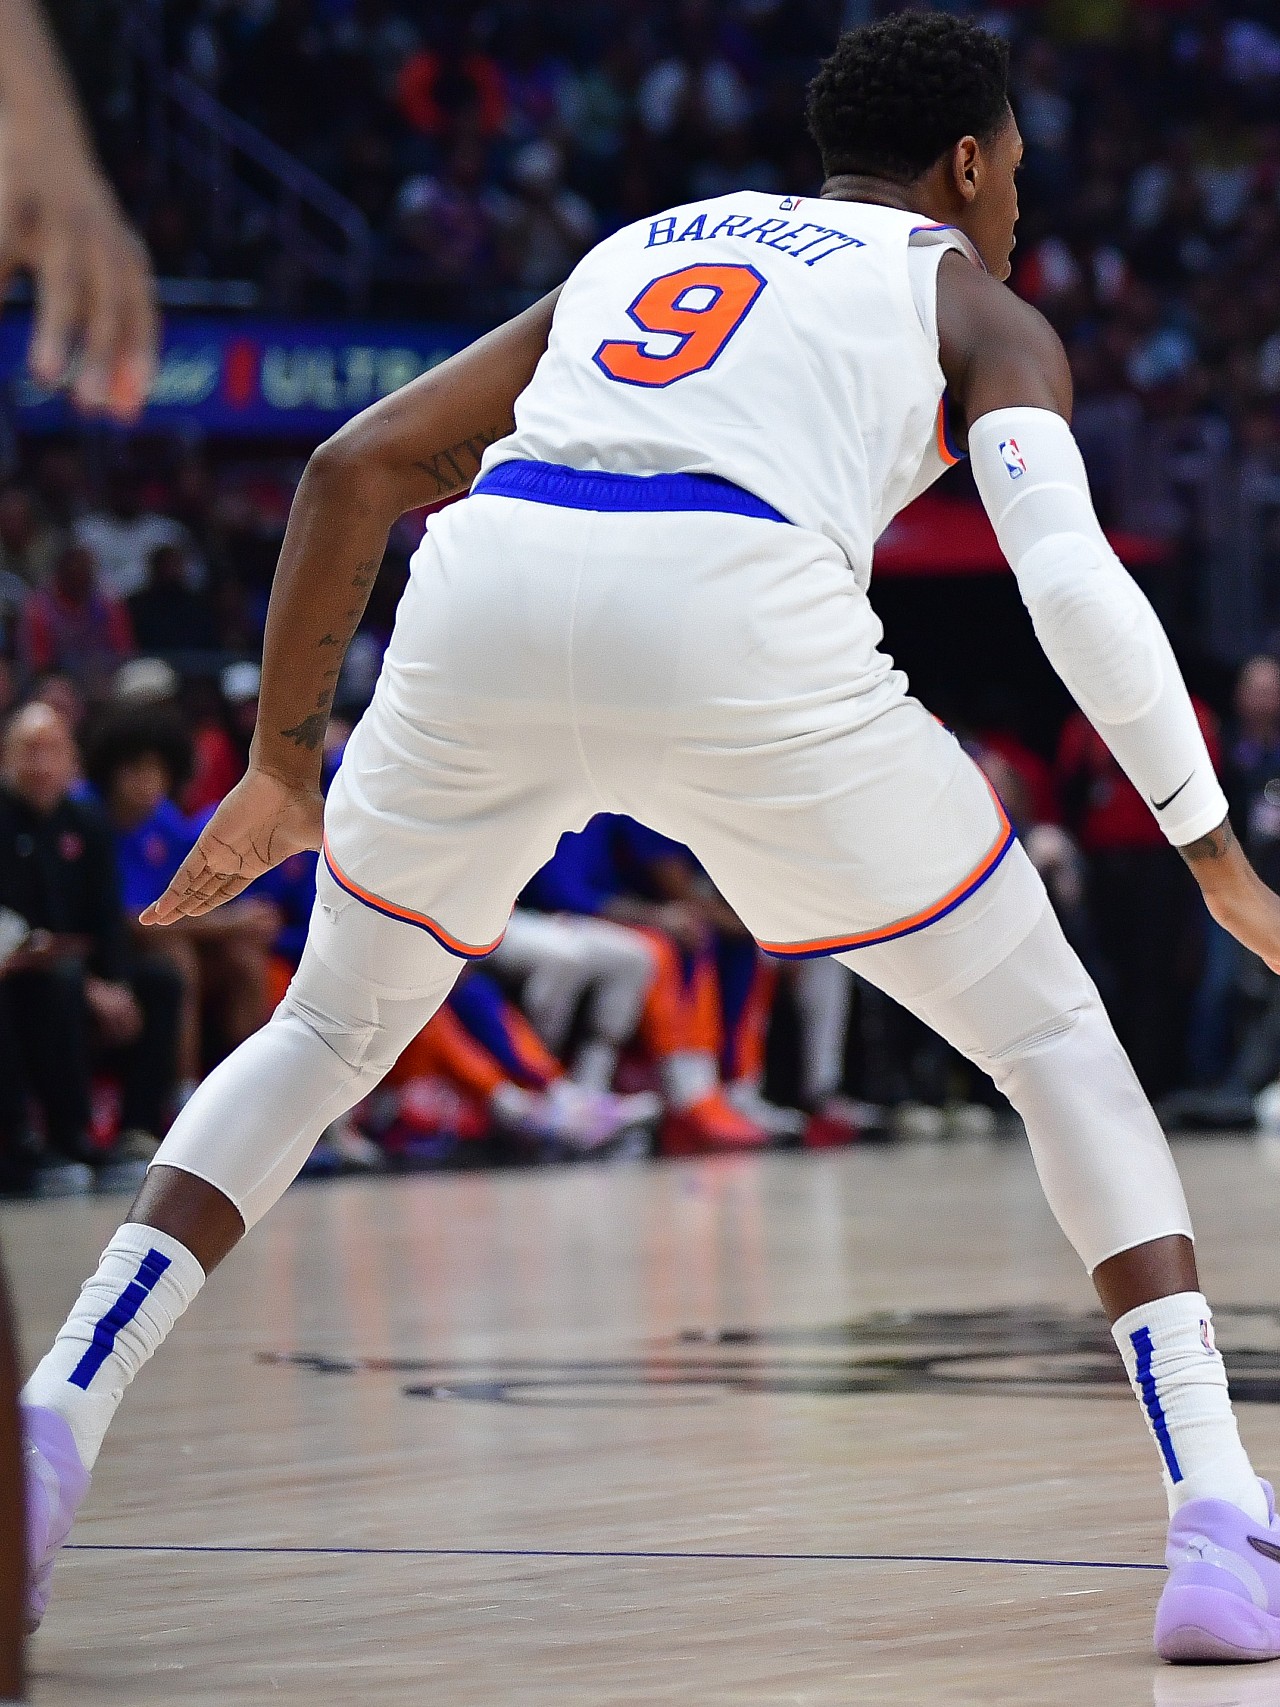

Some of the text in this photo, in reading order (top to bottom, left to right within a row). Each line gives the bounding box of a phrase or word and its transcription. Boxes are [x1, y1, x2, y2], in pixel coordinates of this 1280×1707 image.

[644, 214, 867, 266] BARRETT
[592, 262, 768, 389] 9
[260, 346, 452, 410] ULTR
